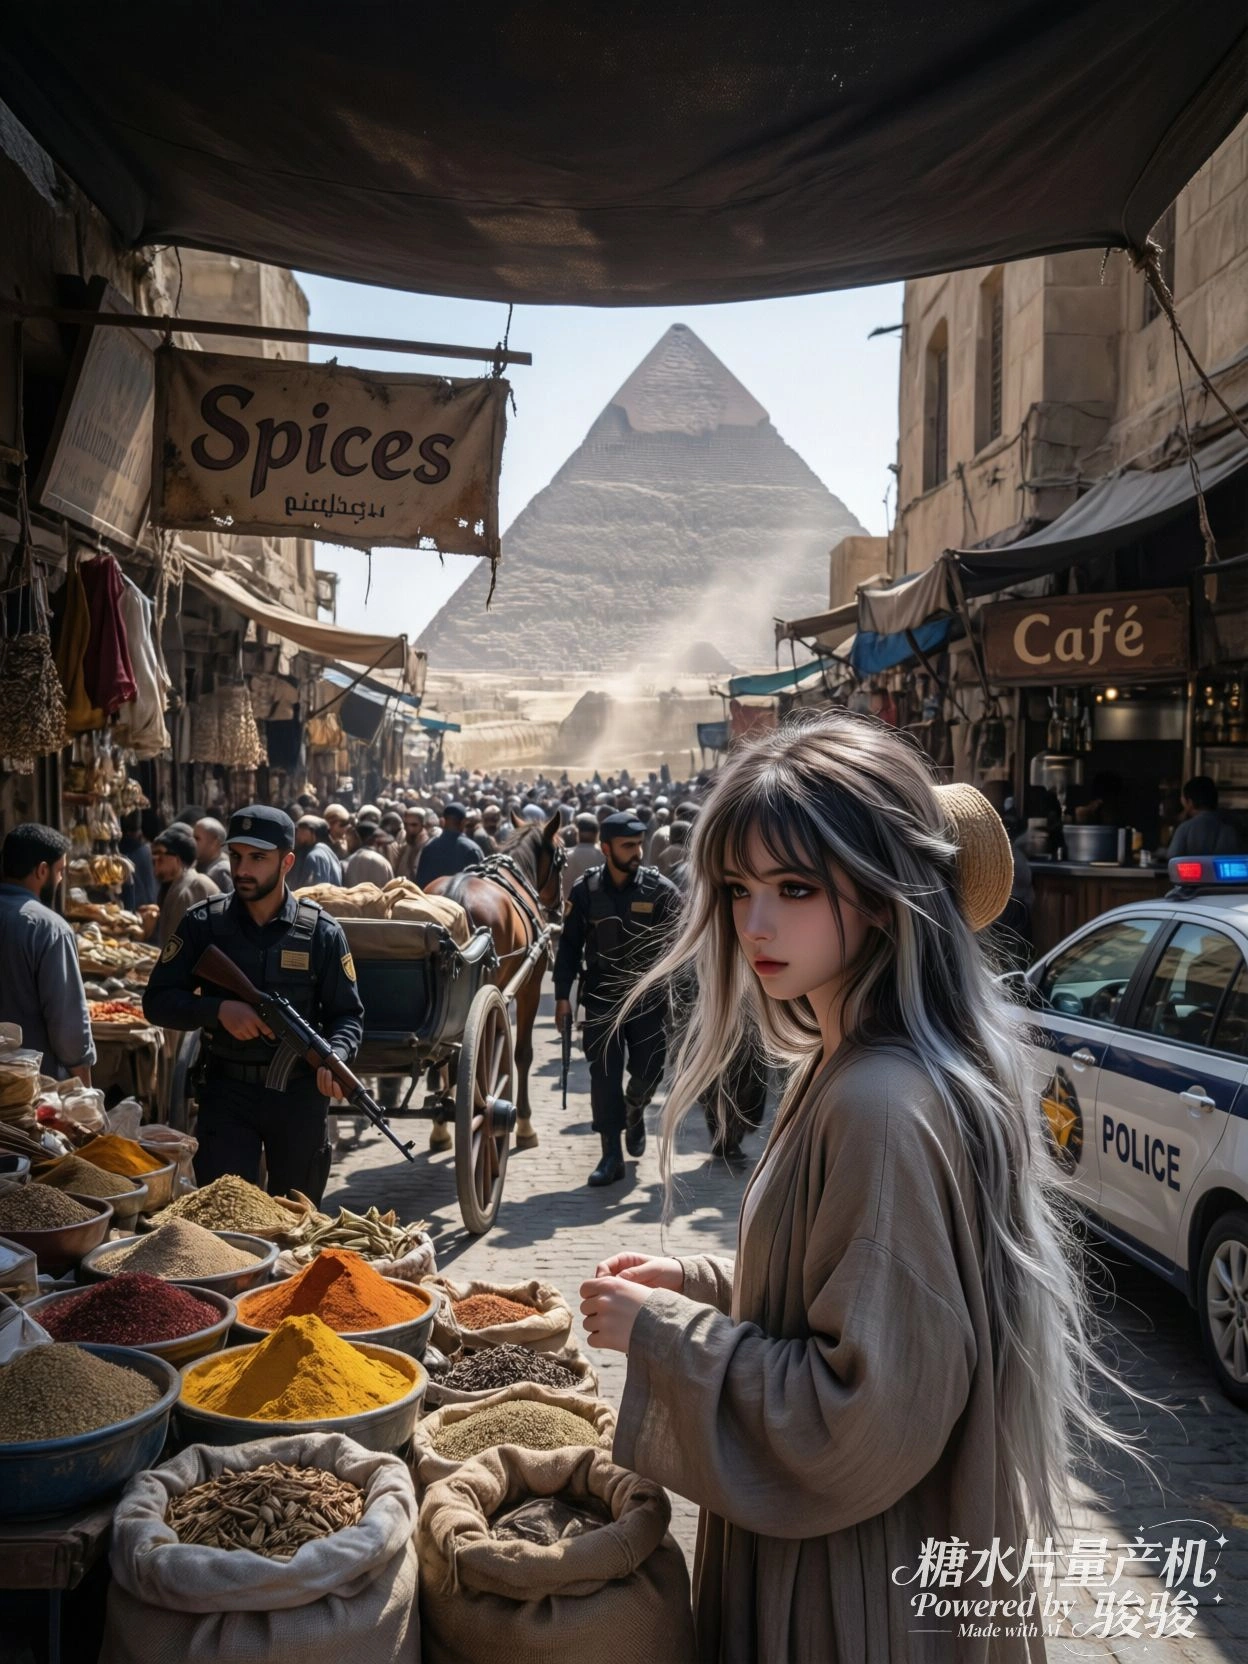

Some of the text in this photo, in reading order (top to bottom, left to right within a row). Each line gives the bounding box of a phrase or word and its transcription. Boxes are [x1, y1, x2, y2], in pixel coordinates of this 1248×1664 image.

[191, 384, 455, 498] Spices
[1013, 605, 1145, 666] Café
[1102, 1114, 1181, 1192] POLICE
